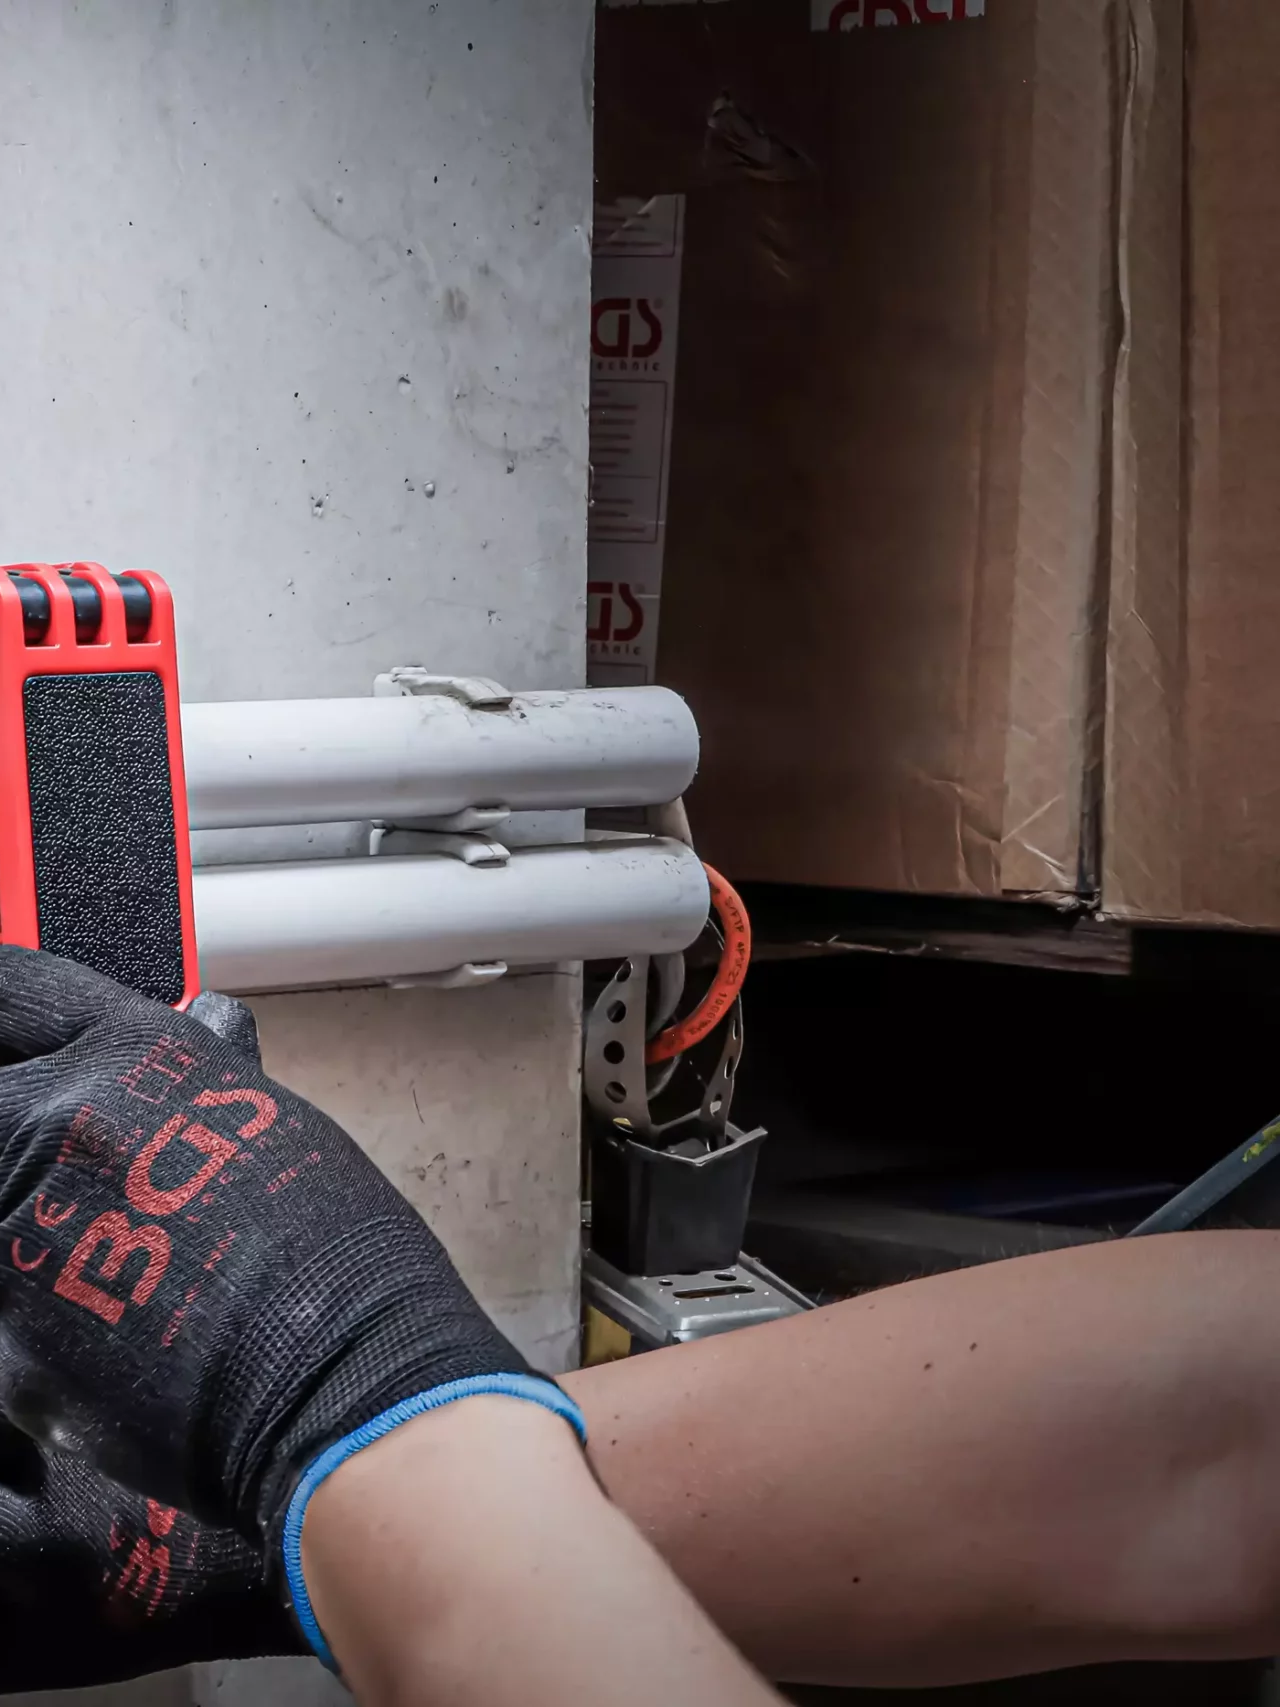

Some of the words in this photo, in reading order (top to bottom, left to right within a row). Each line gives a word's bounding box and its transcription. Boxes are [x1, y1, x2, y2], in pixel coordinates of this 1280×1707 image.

[590, 298, 662, 358] GS
[593, 359, 661, 372] echnic
[587, 582, 643, 641] GS
[588, 642, 642, 655] chnic
